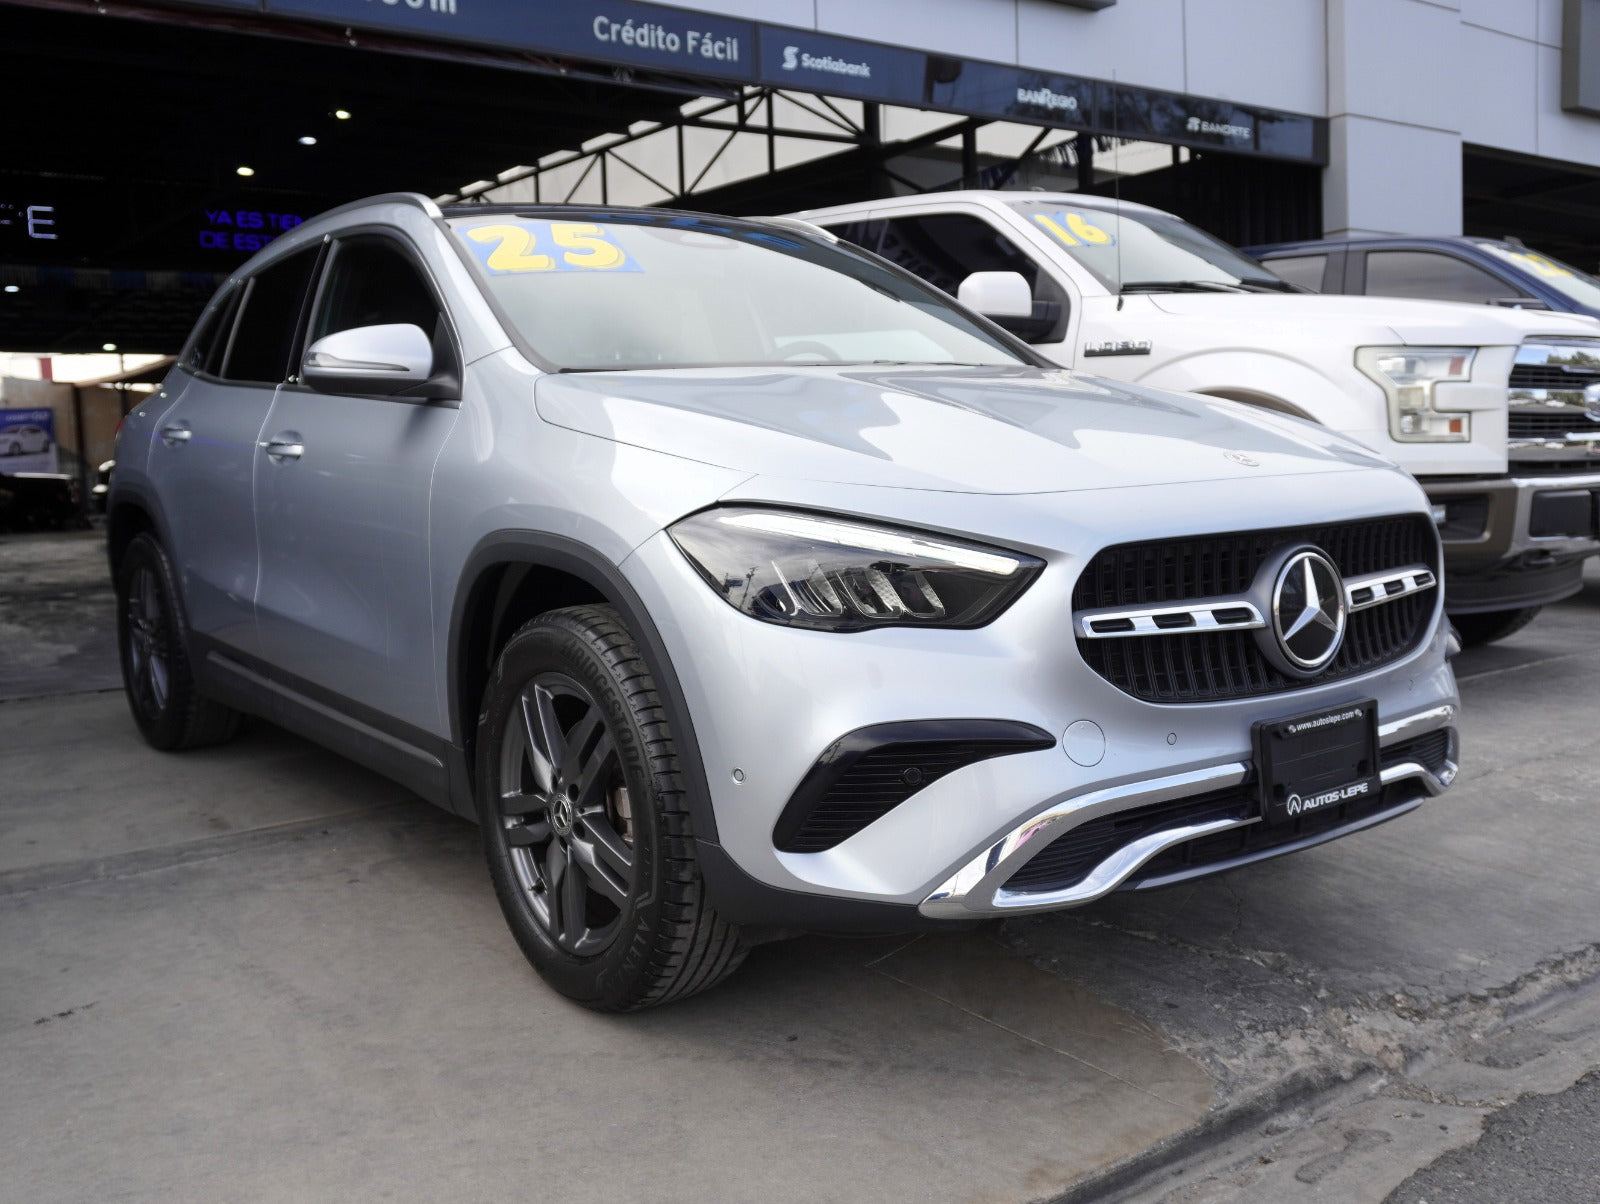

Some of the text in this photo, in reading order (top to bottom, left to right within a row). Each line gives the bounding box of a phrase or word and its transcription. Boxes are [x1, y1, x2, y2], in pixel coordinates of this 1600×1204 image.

[593, 15, 739, 61] Crédito Fácil
[801, 52, 871, 78] Scotiabank
[204, 209, 234, 226] YA
[236, 210, 264, 230] ES
[1034, 212, 1112, 247] 16
[200, 230, 231, 249] DE
[466, 223, 626, 271] 25
[1296, 711, 1355, 731] www.autoslepe.com
